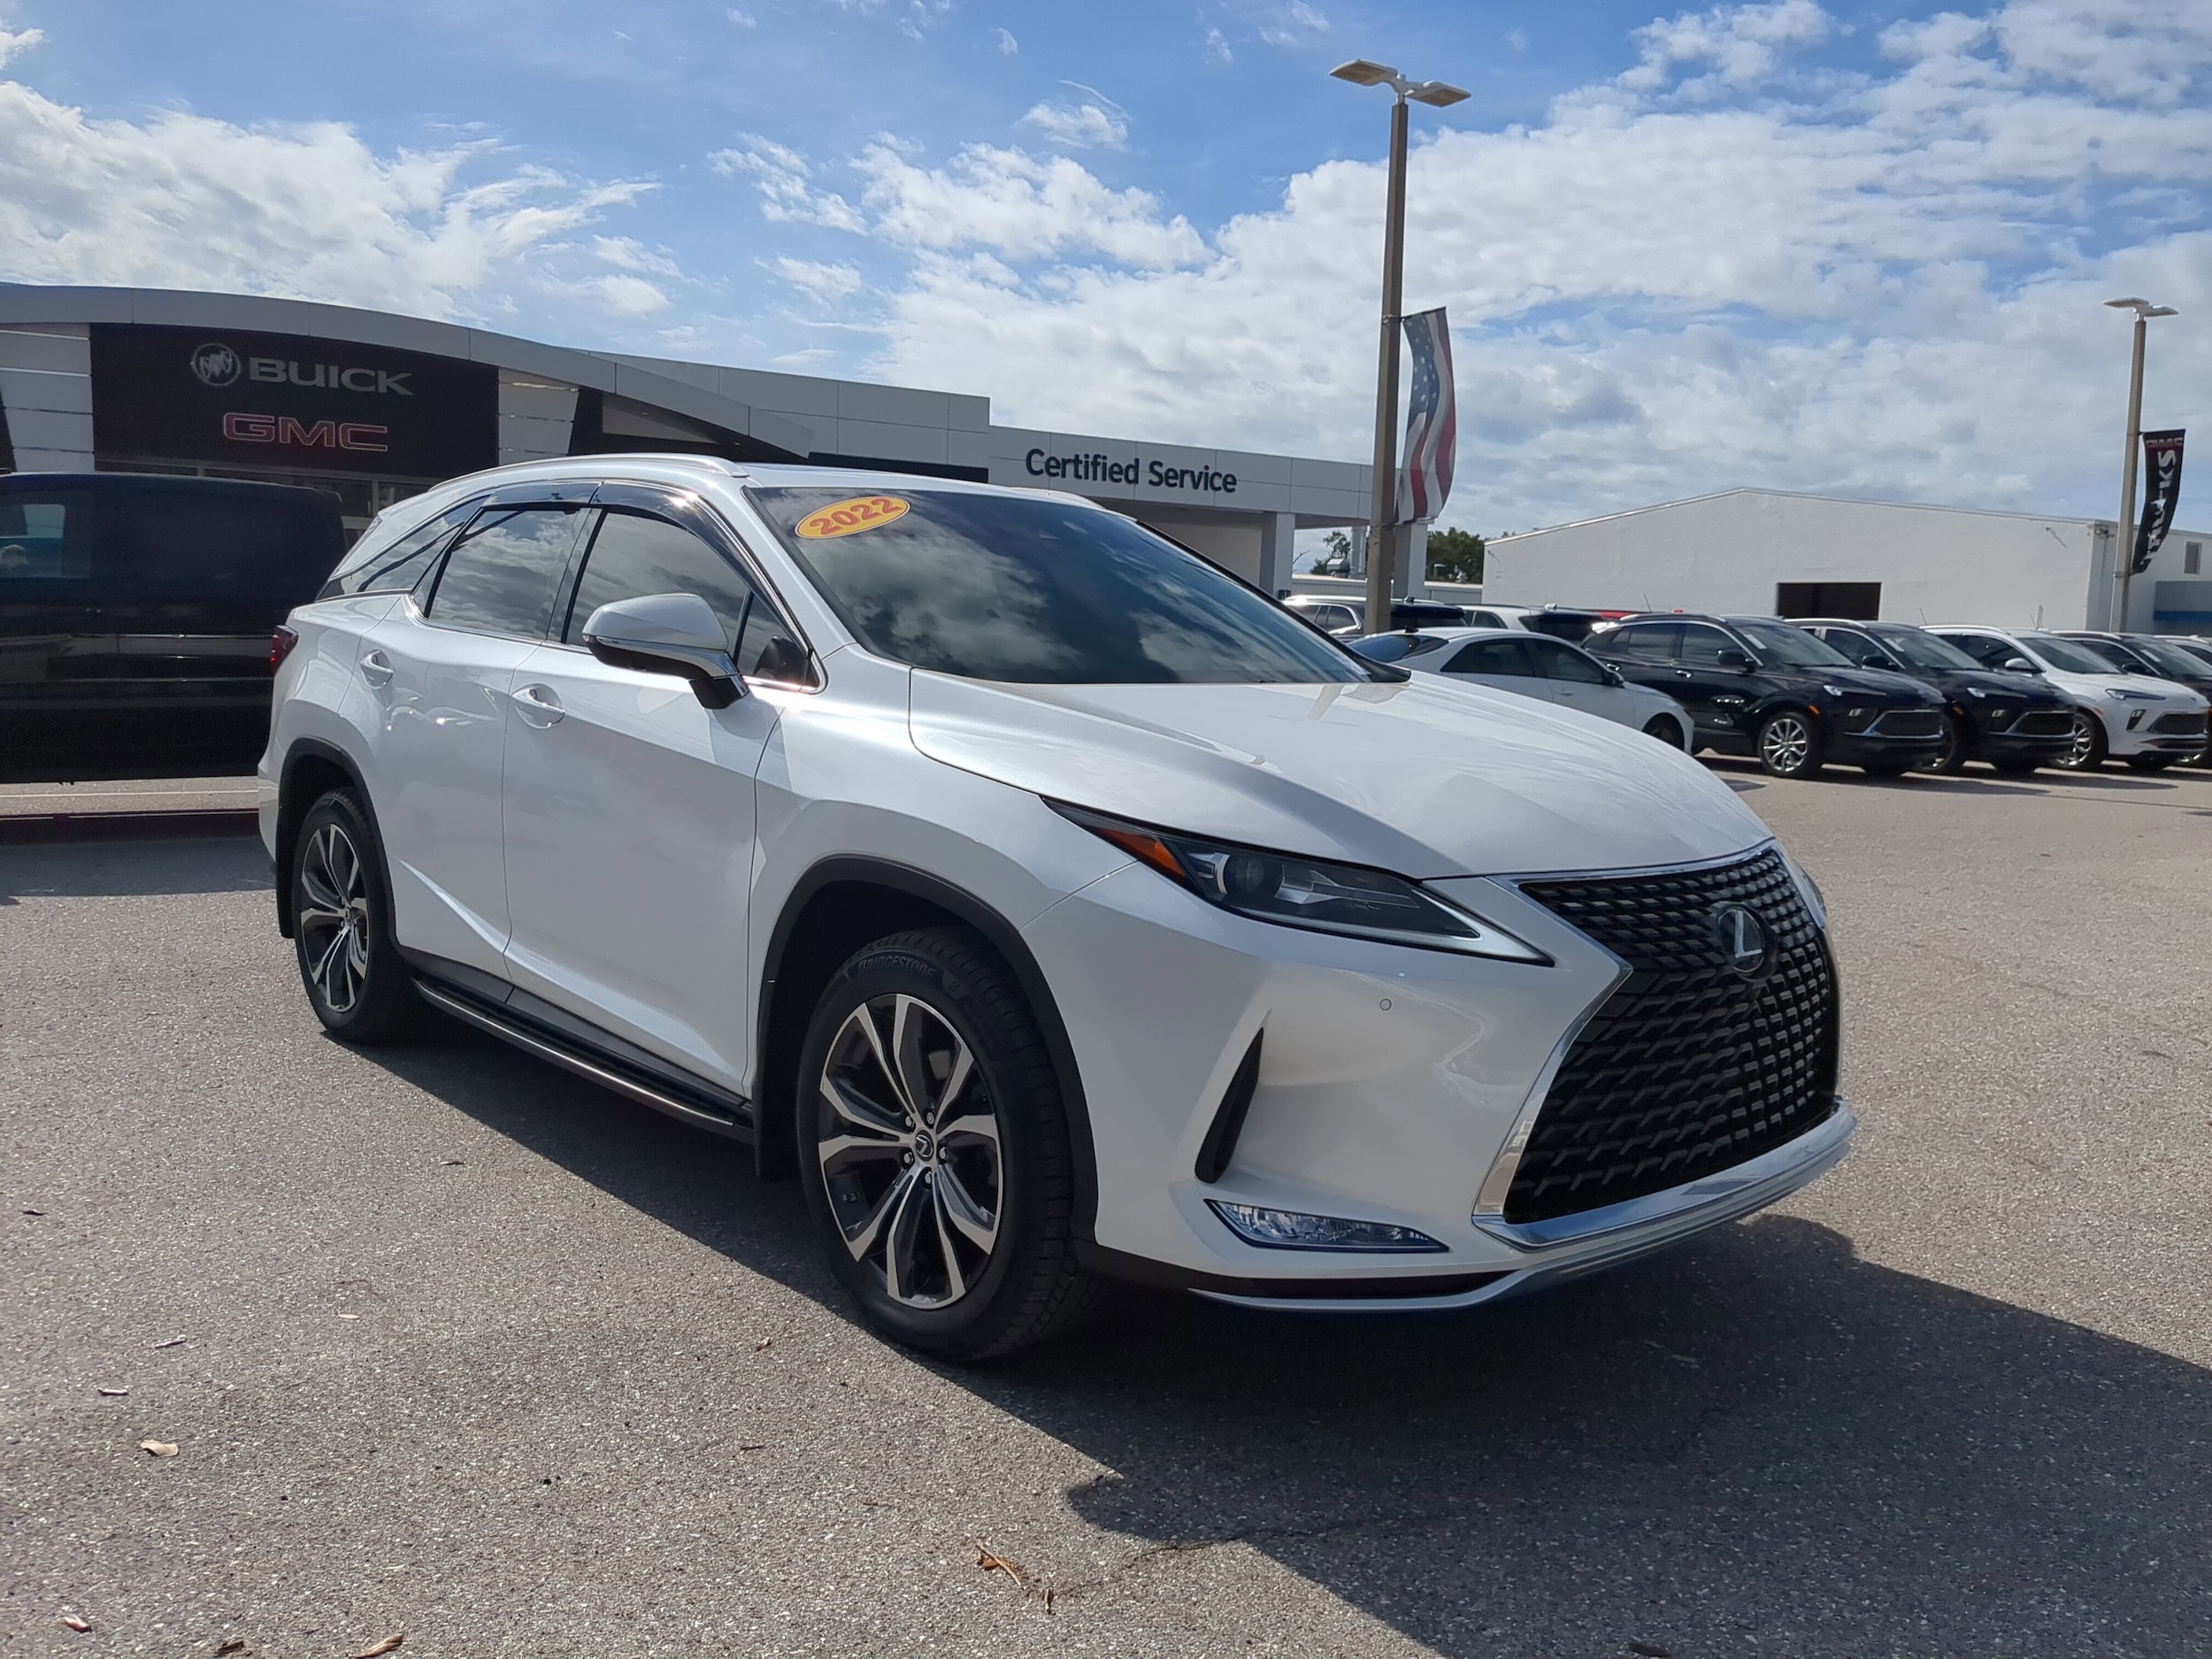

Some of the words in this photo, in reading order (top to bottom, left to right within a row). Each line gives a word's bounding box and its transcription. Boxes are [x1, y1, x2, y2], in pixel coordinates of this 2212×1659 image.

[249, 357, 414, 396] BUICK
[223, 412, 388, 452] GMC
[1025, 449, 1140, 485] Certified
[1148, 460, 1237, 493] Service
[809, 497, 902, 535] 2022
